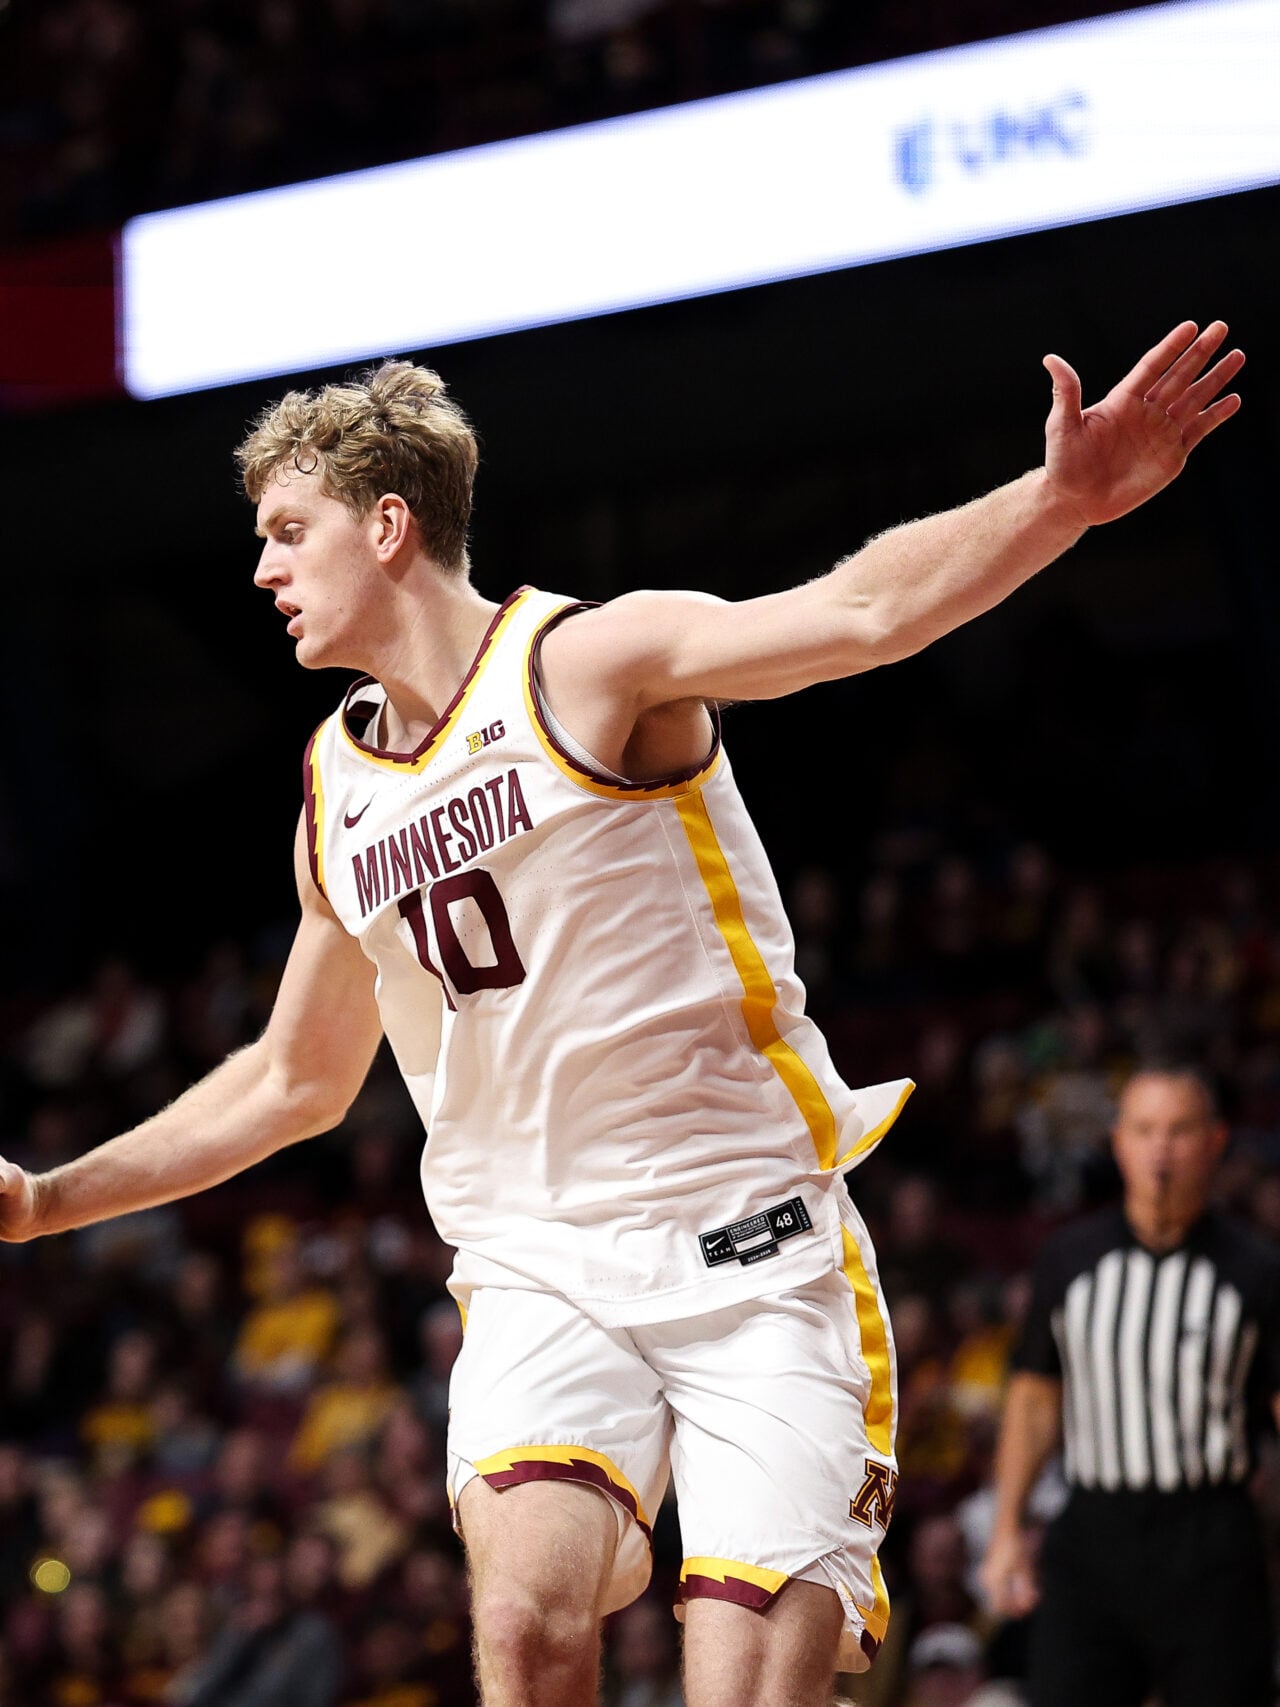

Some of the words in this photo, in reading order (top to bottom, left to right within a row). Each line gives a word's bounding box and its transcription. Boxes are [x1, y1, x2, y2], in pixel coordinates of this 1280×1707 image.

[351, 768, 534, 918] MINNESOTA
[397, 868, 526, 1011] 10
[708, 1247, 731, 1257] TEAM
[776, 1212, 793, 1229] 48
